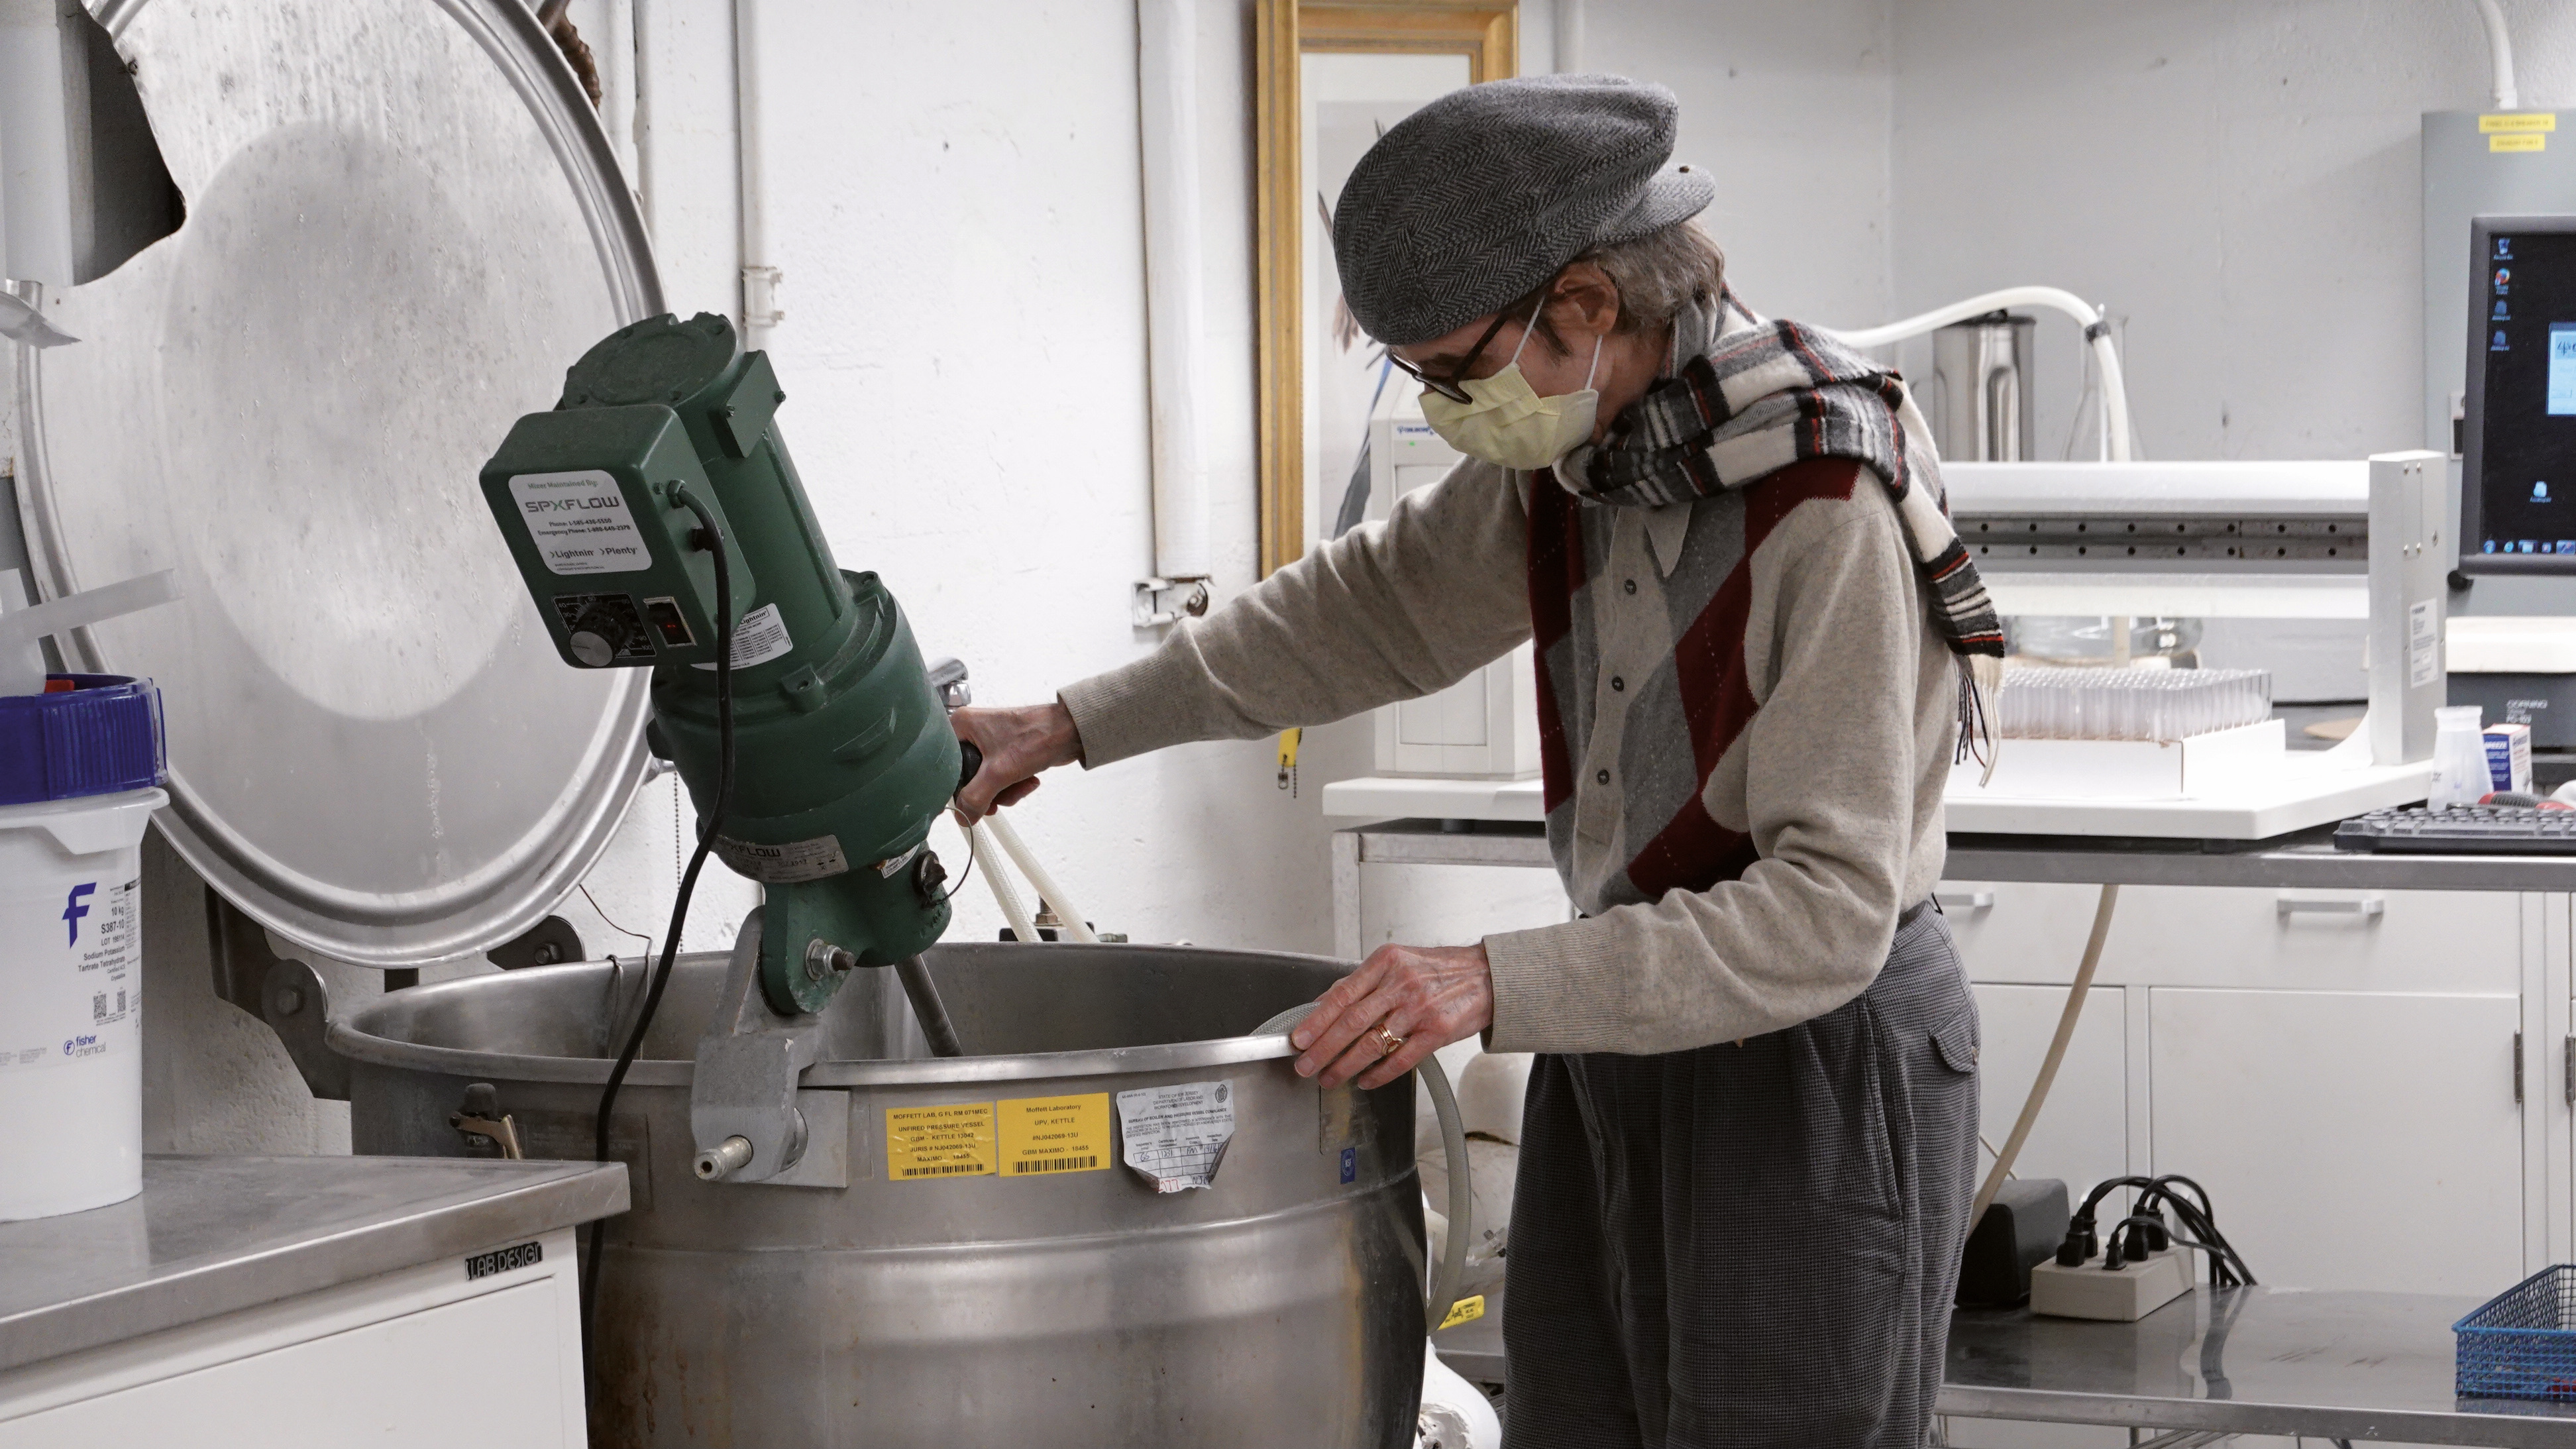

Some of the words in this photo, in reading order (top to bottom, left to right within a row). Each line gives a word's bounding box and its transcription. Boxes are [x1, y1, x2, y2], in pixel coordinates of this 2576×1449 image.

[525, 496, 619, 512] SPXFLOW
[111, 906, 118, 916] 10
[119, 906, 125, 916] kg
[101, 919, 125, 934] S387-10
[101, 937, 110, 946] LOT
[83, 951, 103, 961] Sodium
[104, 945, 125, 956] Potassium
[78, 963, 99, 972] Tartrate
[76, 1035, 96, 1047] fisher
[76, 1042, 106, 1058] chemical
